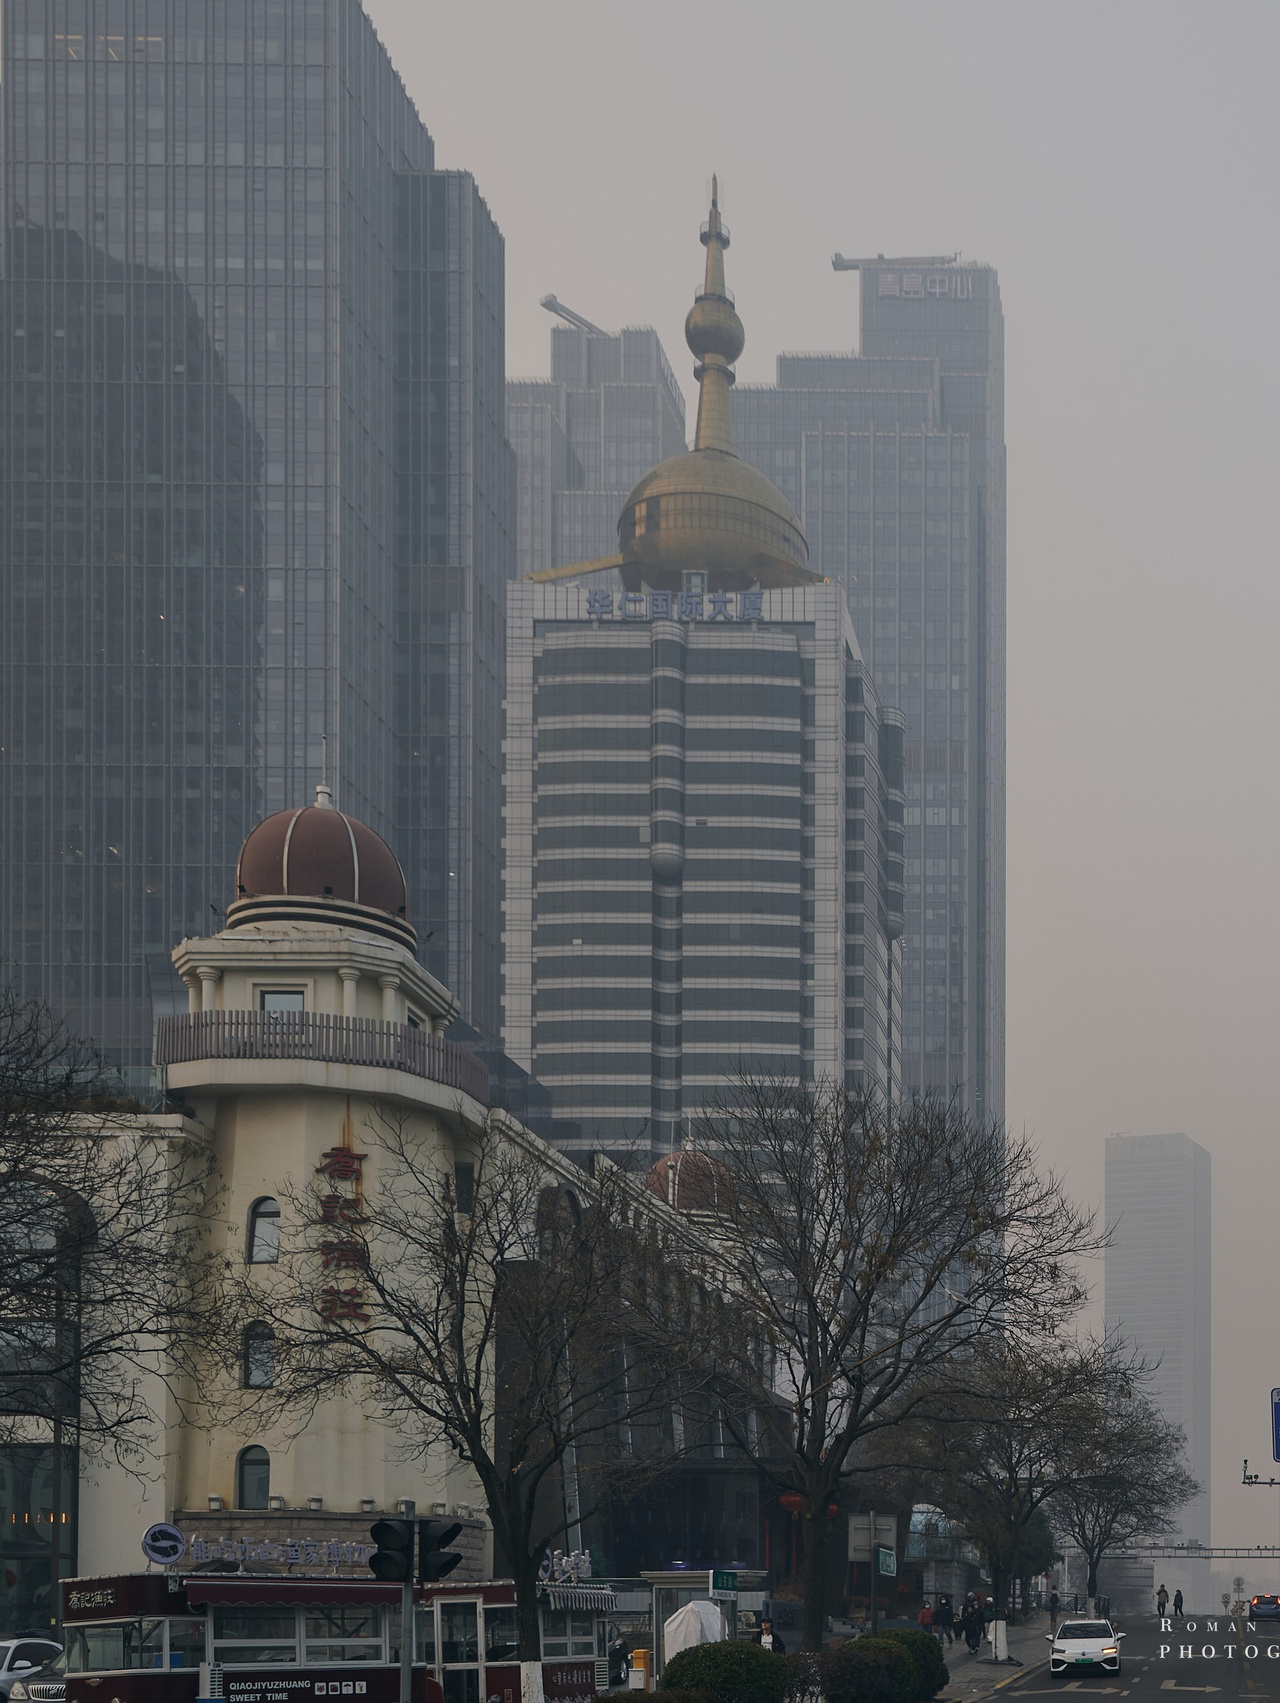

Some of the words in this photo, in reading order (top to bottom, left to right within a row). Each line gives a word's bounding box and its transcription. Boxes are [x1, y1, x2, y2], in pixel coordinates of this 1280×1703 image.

[586, 589, 764, 621] 华仁国际大厦
[190, 1533, 377, 1567] 能吃饭的渔家博物
[229, 1680, 311, 1690] QIAOJIYUZHUANG
[229, 1693, 262, 1702] SWEET
[265, 1692, 289, 1701] TIME
